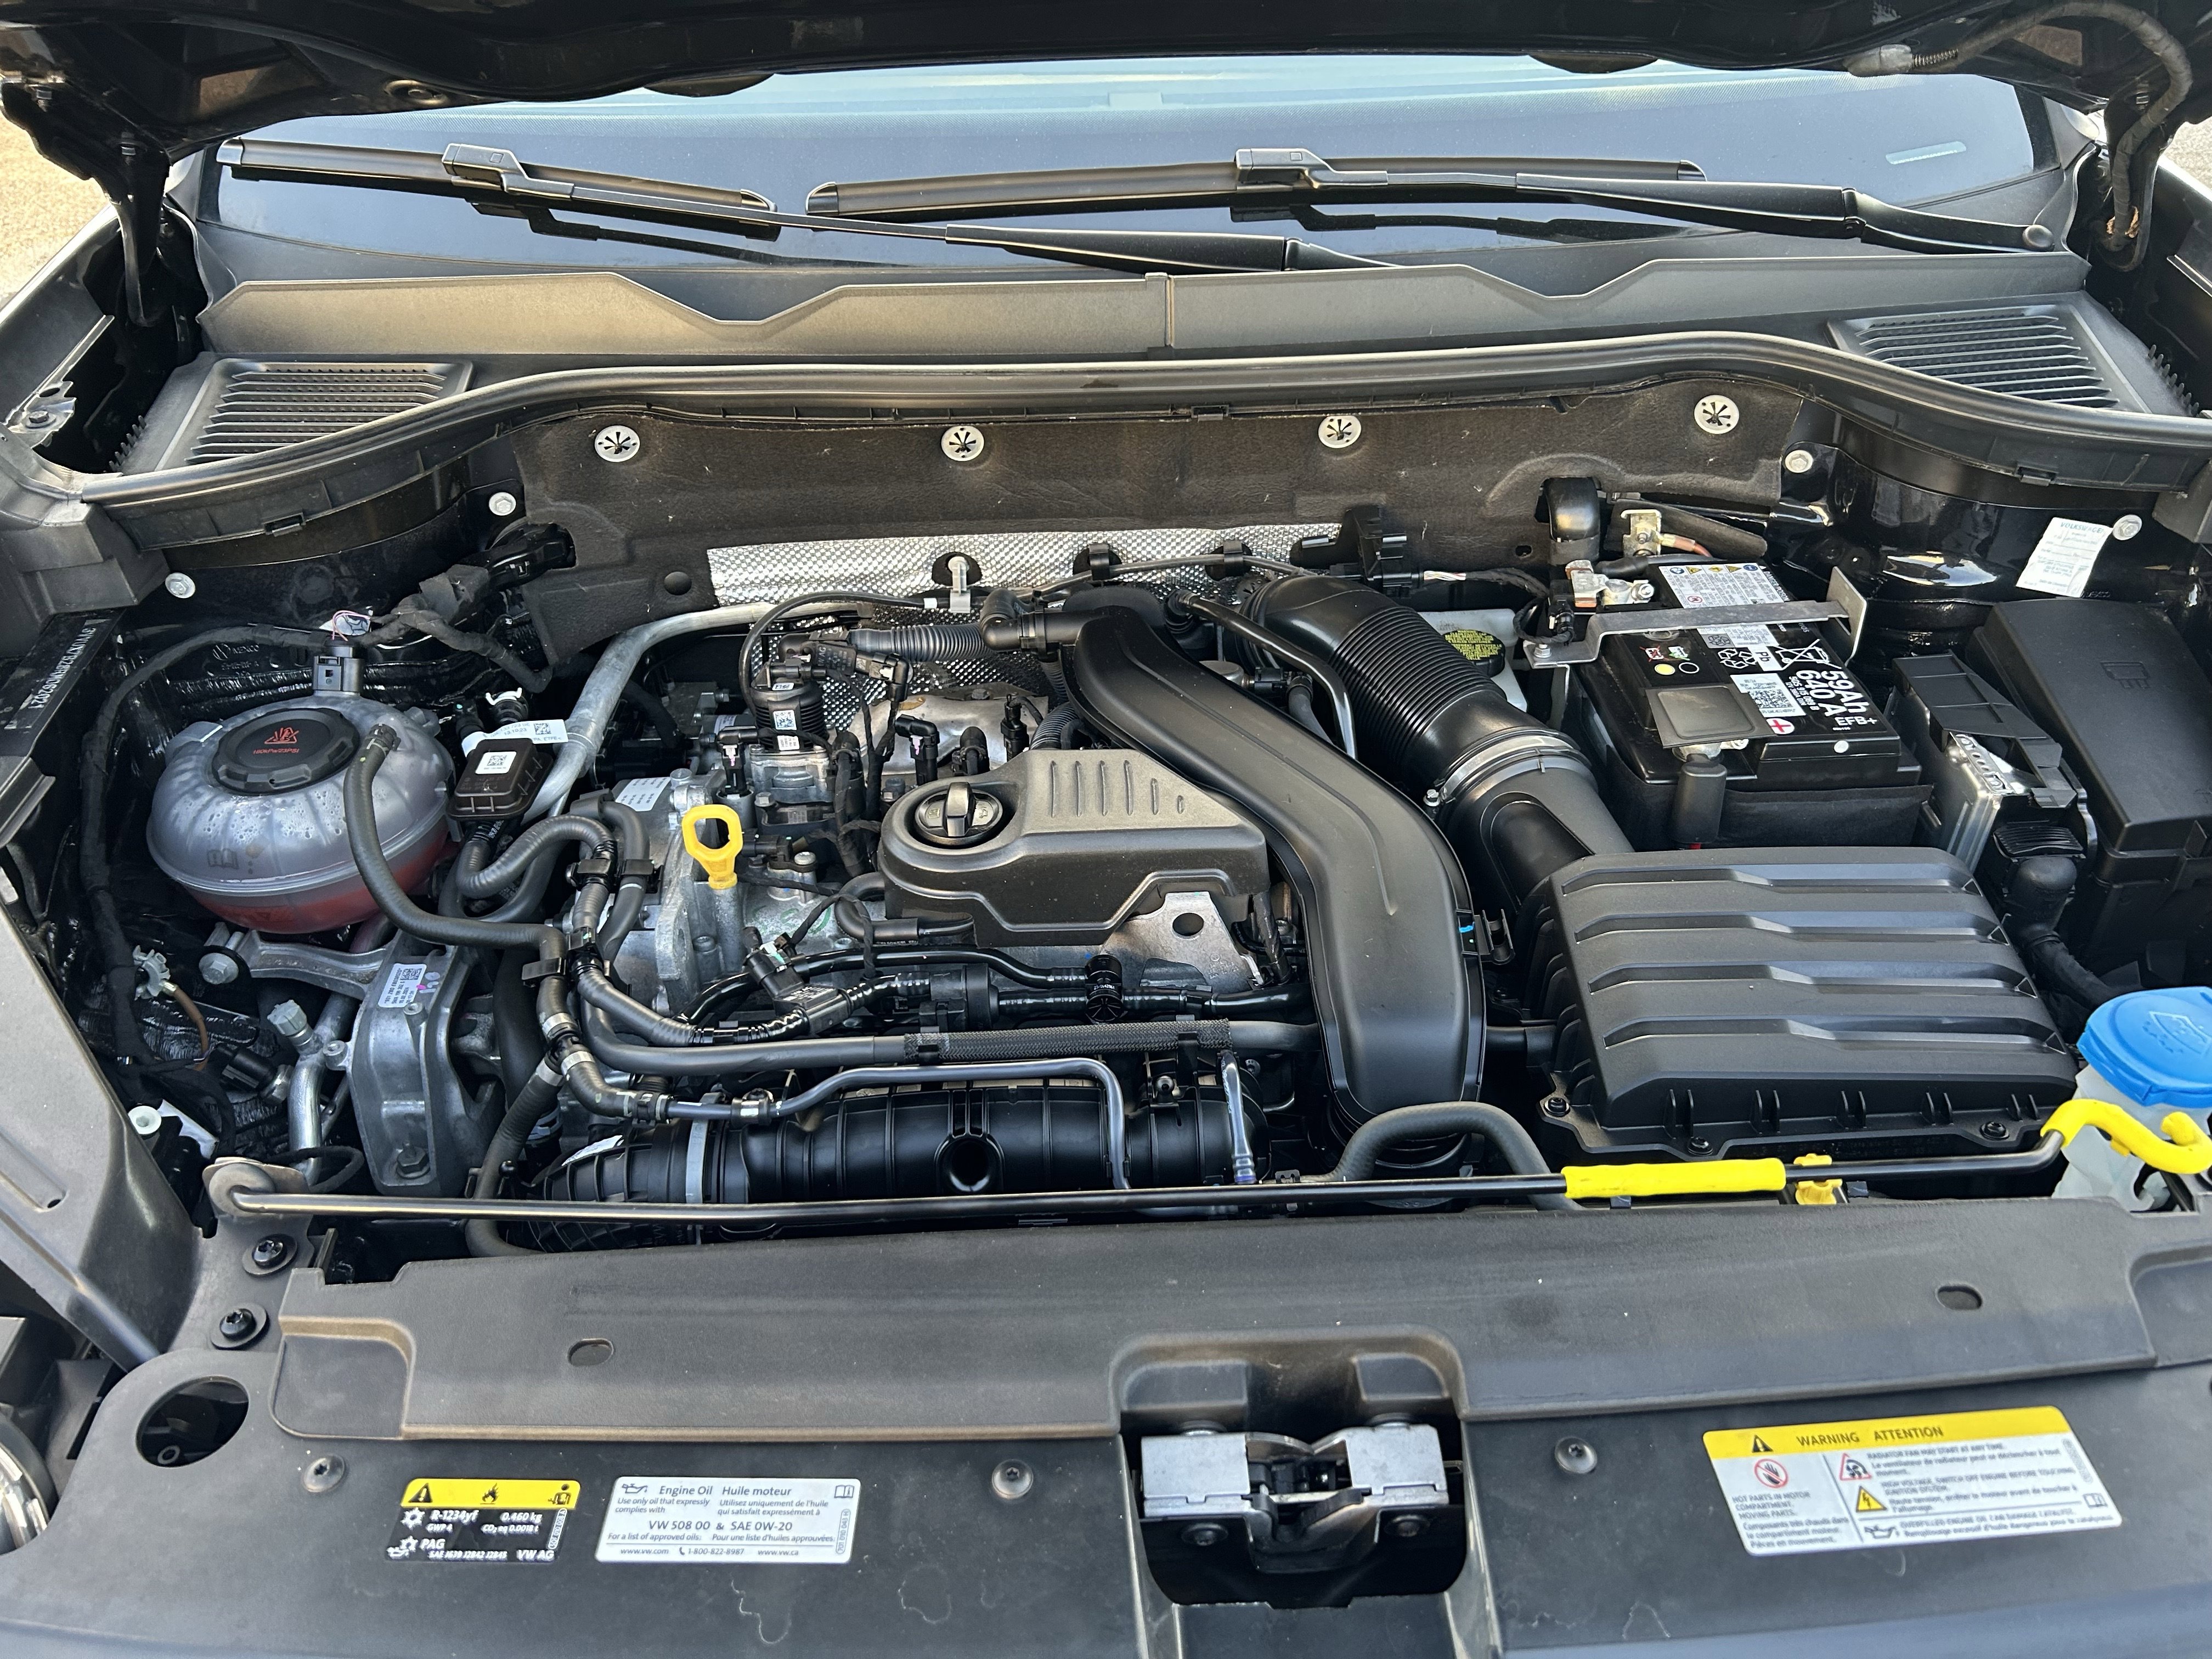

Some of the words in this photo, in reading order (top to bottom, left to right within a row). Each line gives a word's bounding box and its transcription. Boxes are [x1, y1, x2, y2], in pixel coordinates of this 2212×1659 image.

[1756, 651, 1771, 662] Pb
[1796, 670, 1836, 699] 640
[1818, 703, 1848, 716] A
[1821, 670, 1870, 713] 59Ah
[1835, 716, 1877, 726] EFB+
[1796, 1432, 1860, 1446] WARNING
[1874, 1426, 1944, 1441] ATTENTION
[659, 1486, 695, 1497] Engine
[697, 1486, 713, 1494] Oil
[722, 1486, 749, 1496] Huile
[753, 1487, 791, 1496] moteur
[633, 1498, 648, 1506] only
[676, 1498, 710, 1507] expressly
[748, 1500, 793, 1509] uniquement
[430, 1510, 479, 1525] R-1234yf
[500, 1512, 529, 1523] 0.460
[531, 1512, 543, 1524] kg
[762, 1509, 814, 1517] expressément
[426, 1523, 447, 1533] GWP
[447, 1523, 453, 1533] 4
[498, 1525, 507, 1535] eq
[649, 1520, 669, 1530] VW
[671, 1521, 692, 1530] 508
[695, 1521, 710, 1530] 00
[730, 1521, 752, 1530] SAE
[754, 1522, 793, 1531] 0W-20
[650, 1533, 685, 1542] approved
[420, 1538, 445, 1551] PAG
[428, 1550, 444, 1560] SAE
[517, 1549, 537, 1560] VW
[537, 1549, 555, 1561] AG
